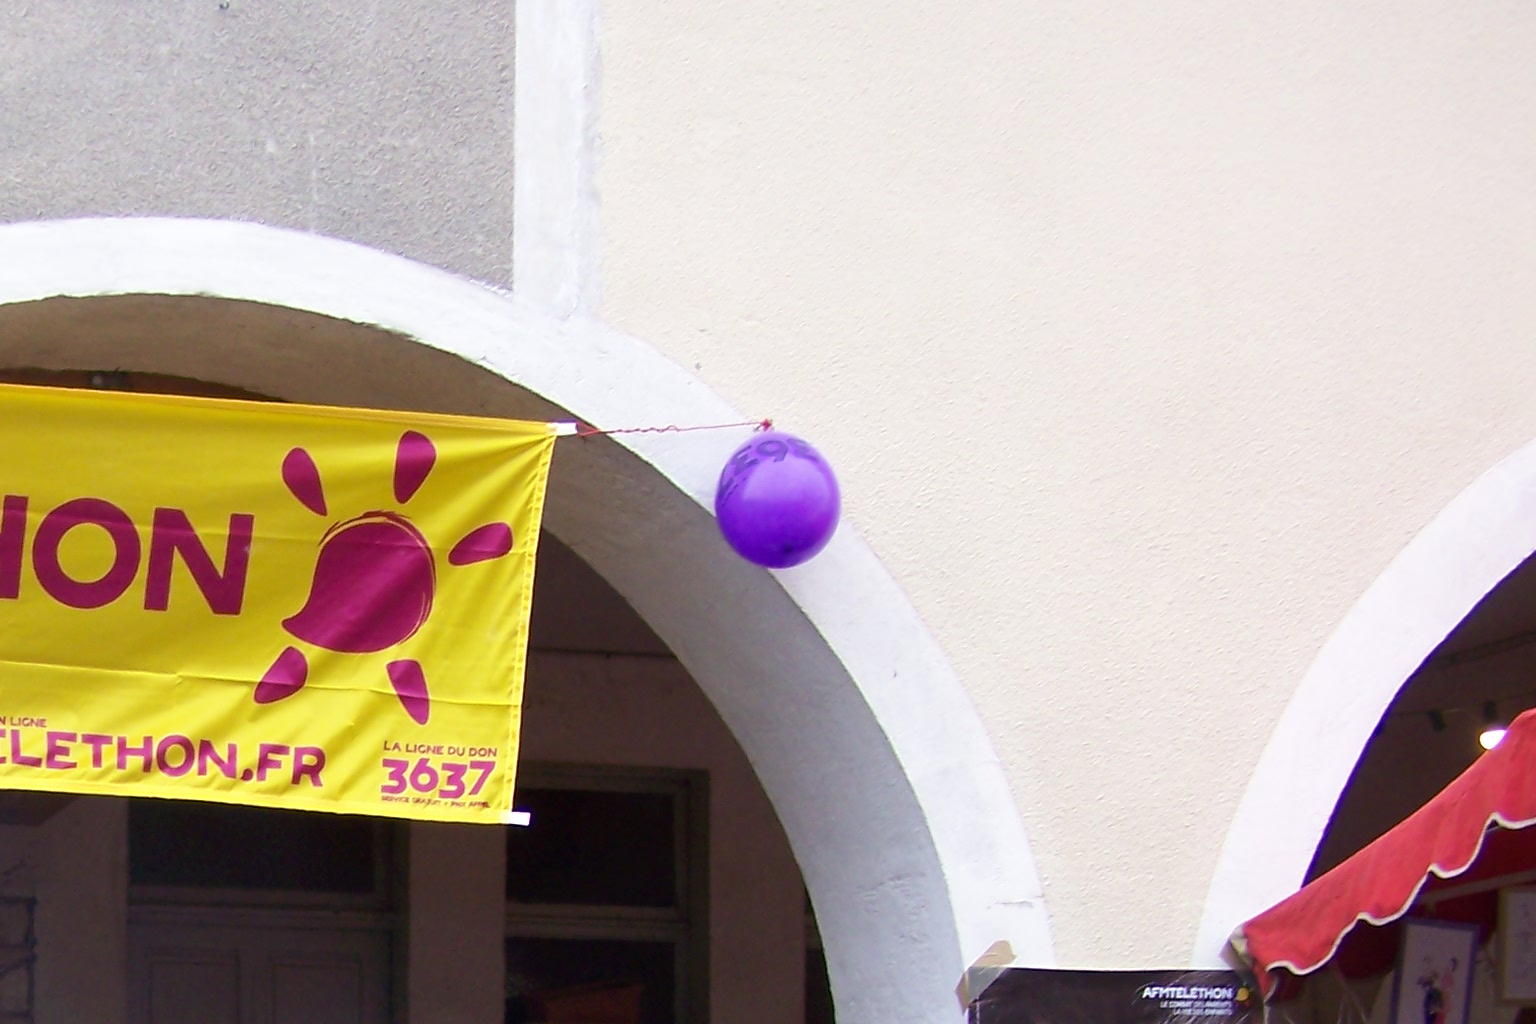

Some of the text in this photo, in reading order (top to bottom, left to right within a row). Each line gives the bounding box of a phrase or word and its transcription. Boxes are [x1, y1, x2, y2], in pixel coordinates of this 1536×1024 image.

[10, 716, 47, 728] LIGNE
[383, 740, 498, 758] LA LIGNE DU DON
[380, 757, 497, 799] 3637
